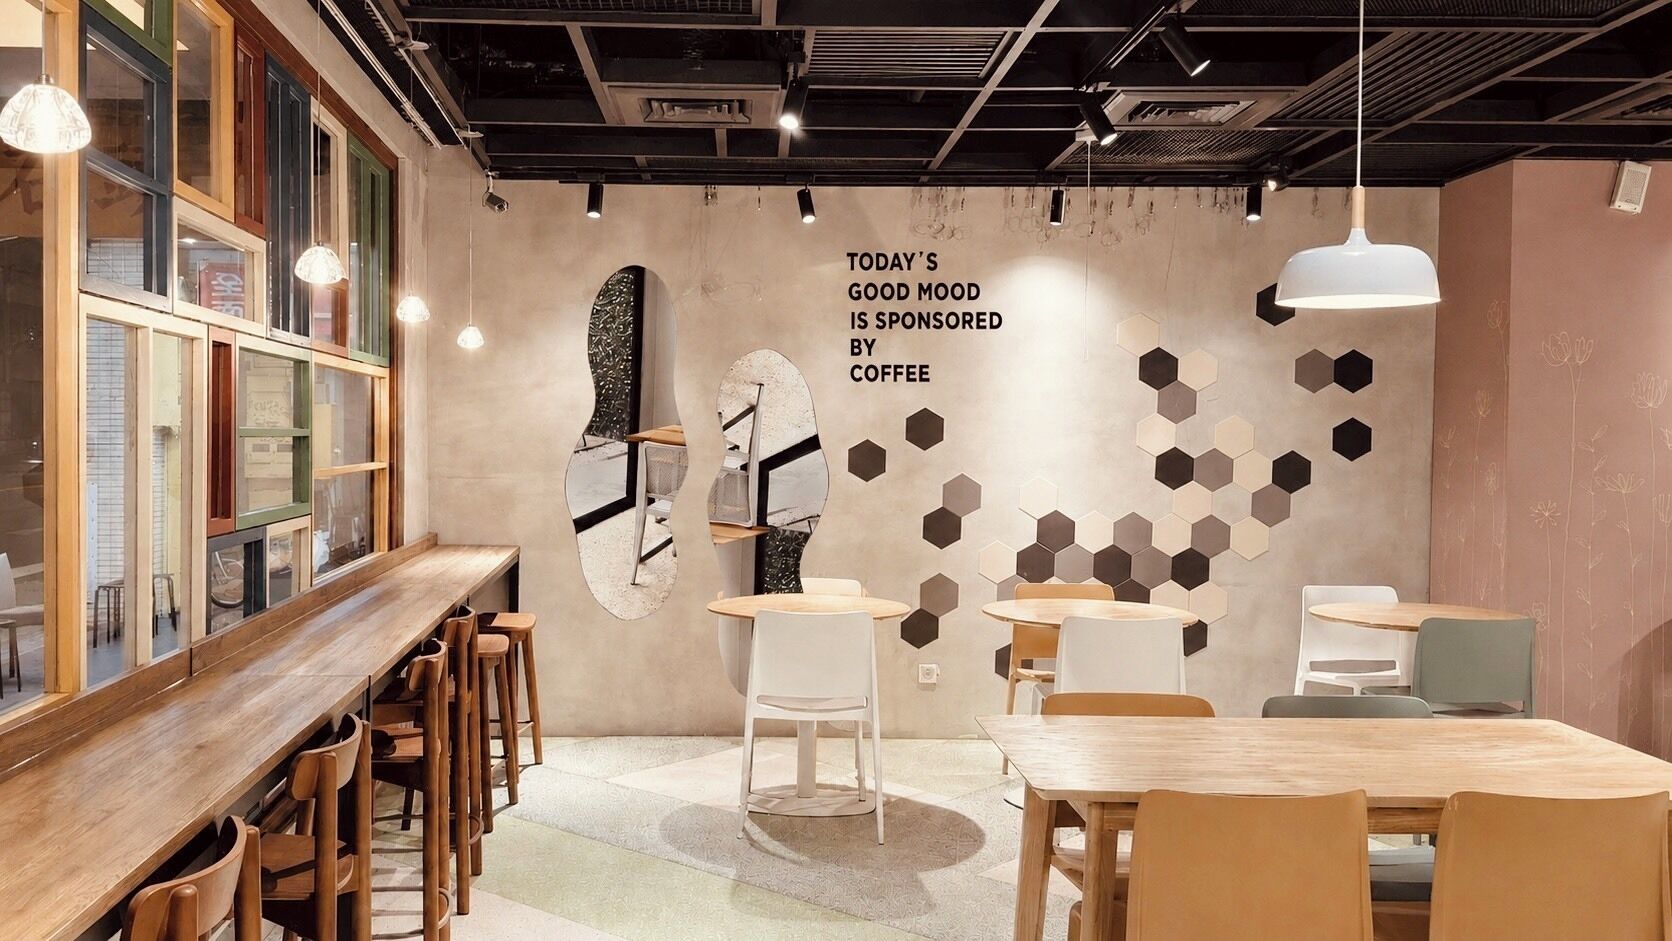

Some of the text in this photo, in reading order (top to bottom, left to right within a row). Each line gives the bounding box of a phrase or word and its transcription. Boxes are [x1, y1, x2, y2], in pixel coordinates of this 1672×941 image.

[847, 251, 938, 271] TODAY'S
[848, 283, 980, 301] GOOD MOOD
[851, 311, 1002, 330] IS SPONSORED
[851, 338, 876, 356] BY
[850, 365, 930, 382] COFFEE
